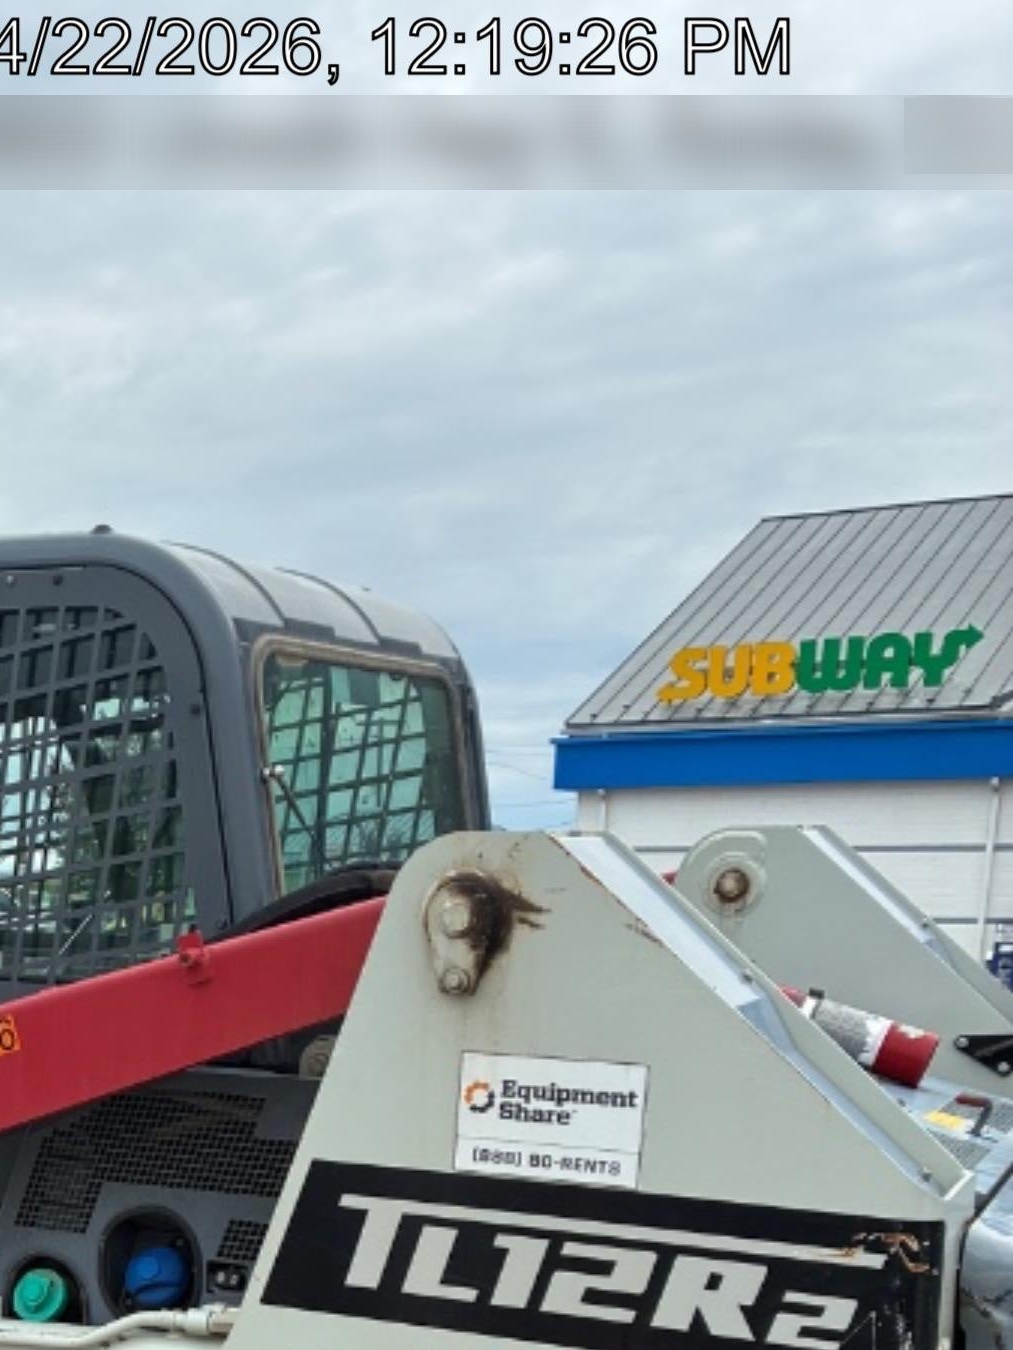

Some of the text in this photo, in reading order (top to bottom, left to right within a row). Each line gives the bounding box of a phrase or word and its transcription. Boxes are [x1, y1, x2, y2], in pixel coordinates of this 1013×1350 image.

[657, 624, 983, 704] SUBWAY
[501, 1079, 639, 1108] Equipment
[499, 1101, 571, 1126] Share
